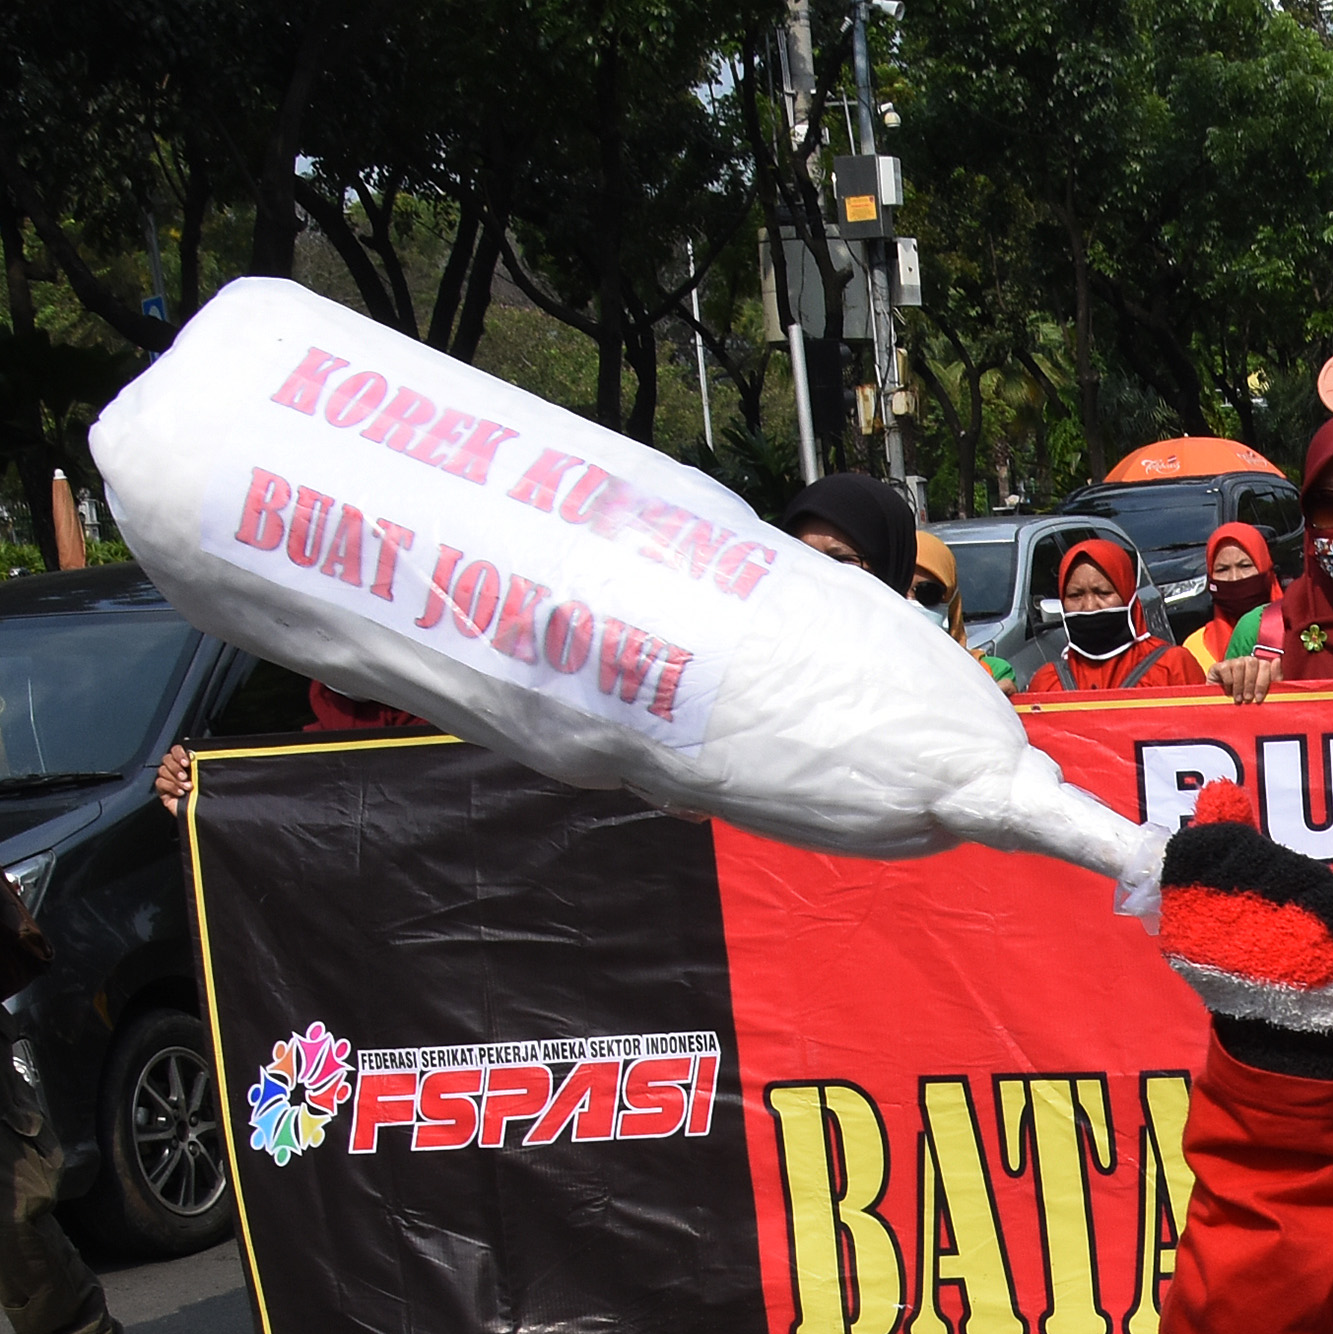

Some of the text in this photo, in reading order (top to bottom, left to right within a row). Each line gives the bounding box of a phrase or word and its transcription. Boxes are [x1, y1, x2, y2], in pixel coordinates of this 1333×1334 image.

[270, 347, 519, 485] KOREK
[234, 466, 694, 723] BUAT JOKOWI
[348, 1054, 720, 1154] FSPASI
[360, 1032, 719, 1071] FEDERASI SERIKAT PEKERJA ANEKA SEKTOR INDONESIA
